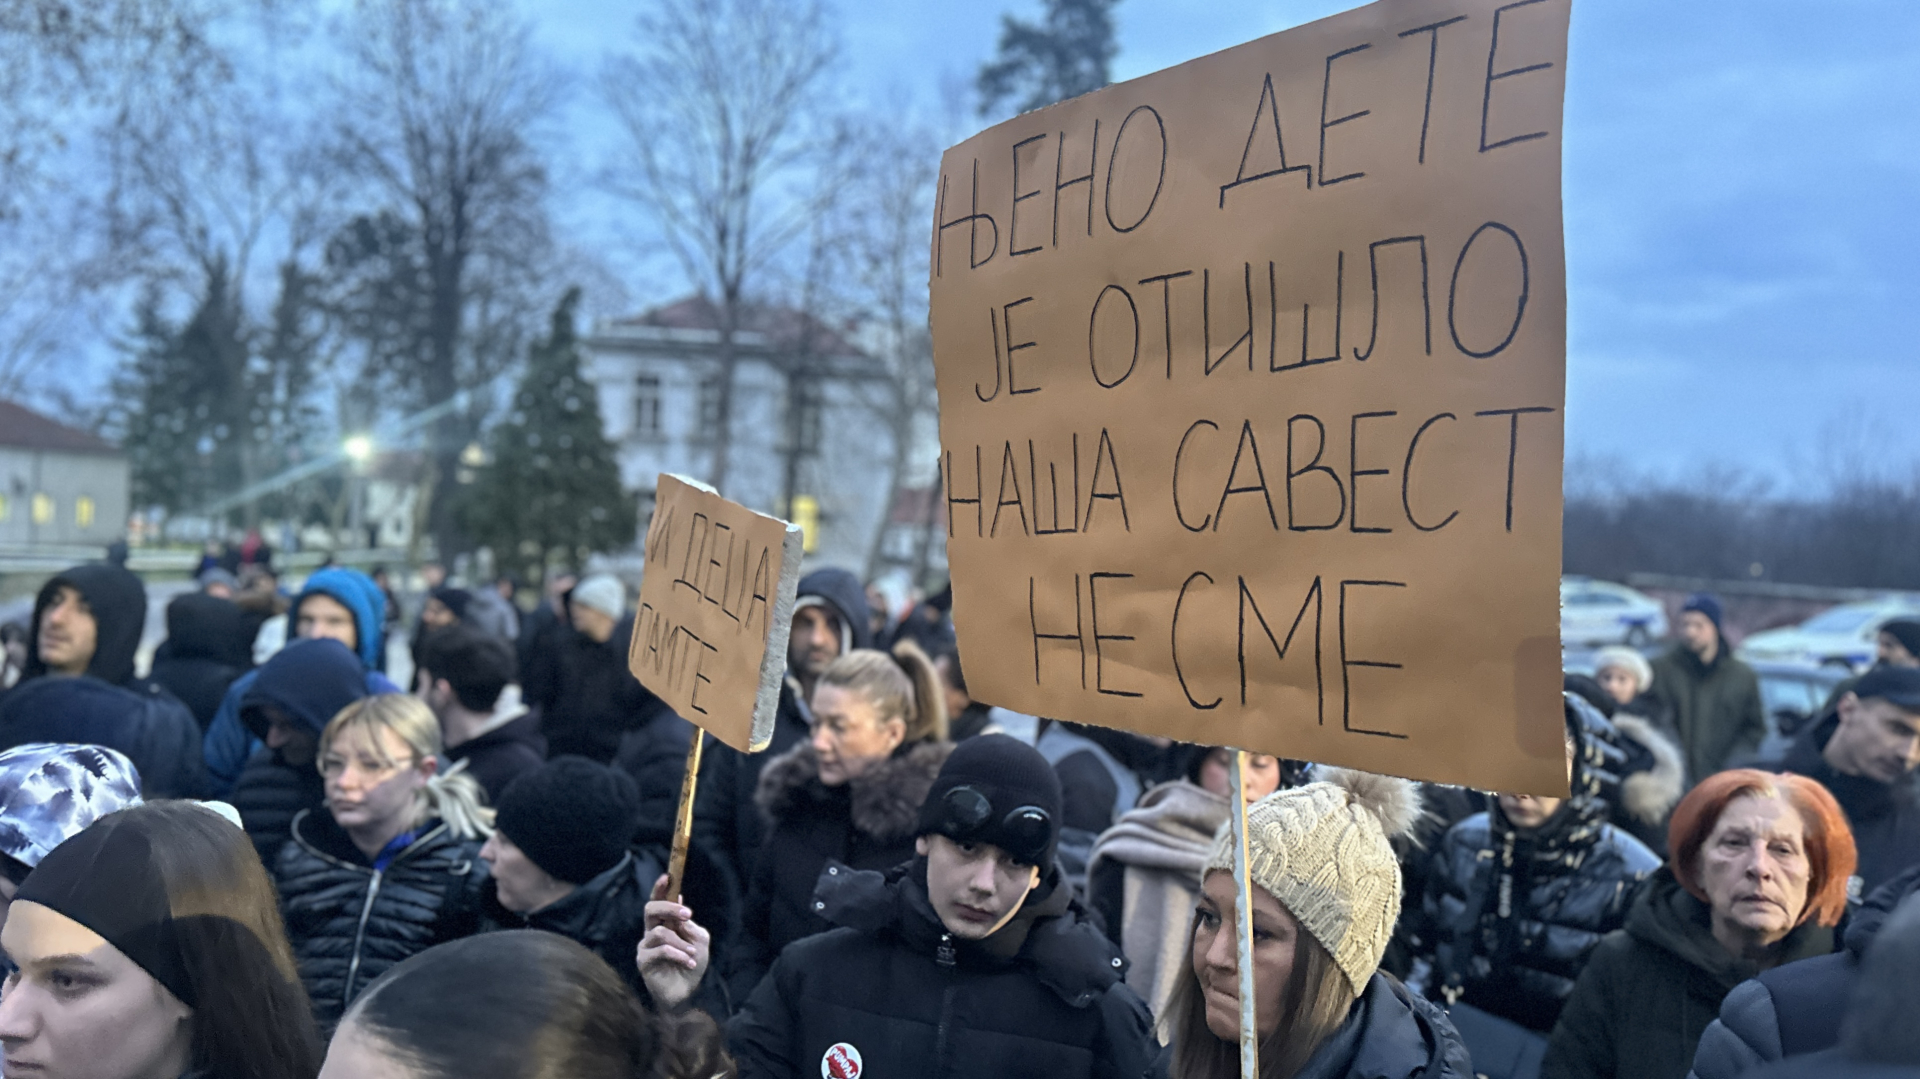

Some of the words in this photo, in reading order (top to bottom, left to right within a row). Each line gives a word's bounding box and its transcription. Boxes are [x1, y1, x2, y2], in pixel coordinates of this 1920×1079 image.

[937, 105, 1167, 277] ЊЕНО
[1219, 0, 1553, 209] ДЕТЕ
[975, 297, 1041, 402] ЈЕ
[1089, 222, 1529, 389] ОТИШЛО
[947, 428, 1131, 538] НАША
[1172, 406, 1556, 533] САВЕСТ
[672, 512, 768, 644] ДЕЦА
